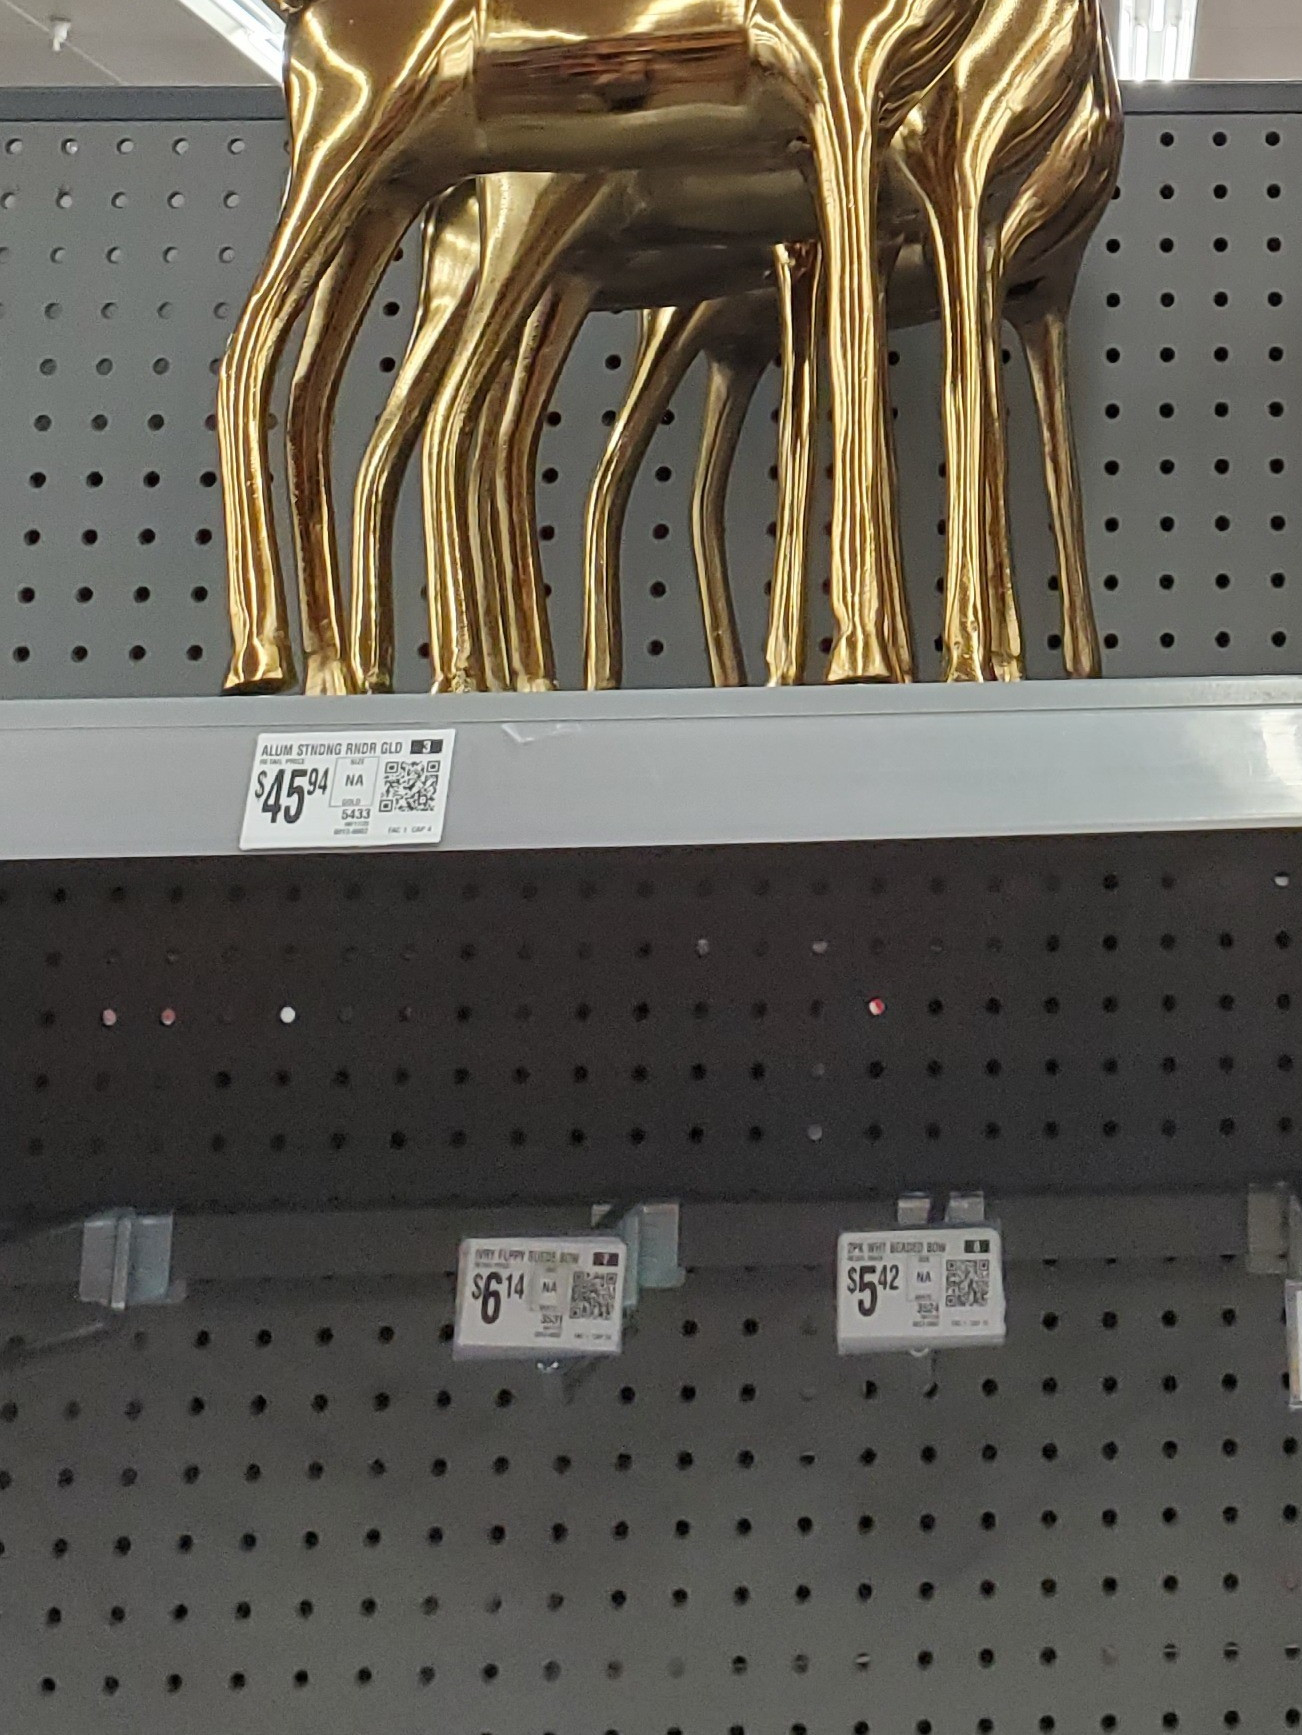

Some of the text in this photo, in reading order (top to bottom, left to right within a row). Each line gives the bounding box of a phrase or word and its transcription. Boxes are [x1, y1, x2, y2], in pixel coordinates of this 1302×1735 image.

[261, 742, 430, 756] ALUM STNDNG RNDR GLD 3
[345, 775, 364, 786] NA
[341, 809, 371, 820] 5433
[917, 1271, 931, 1283] NA
[542, 1281, 557, 1293] NA
